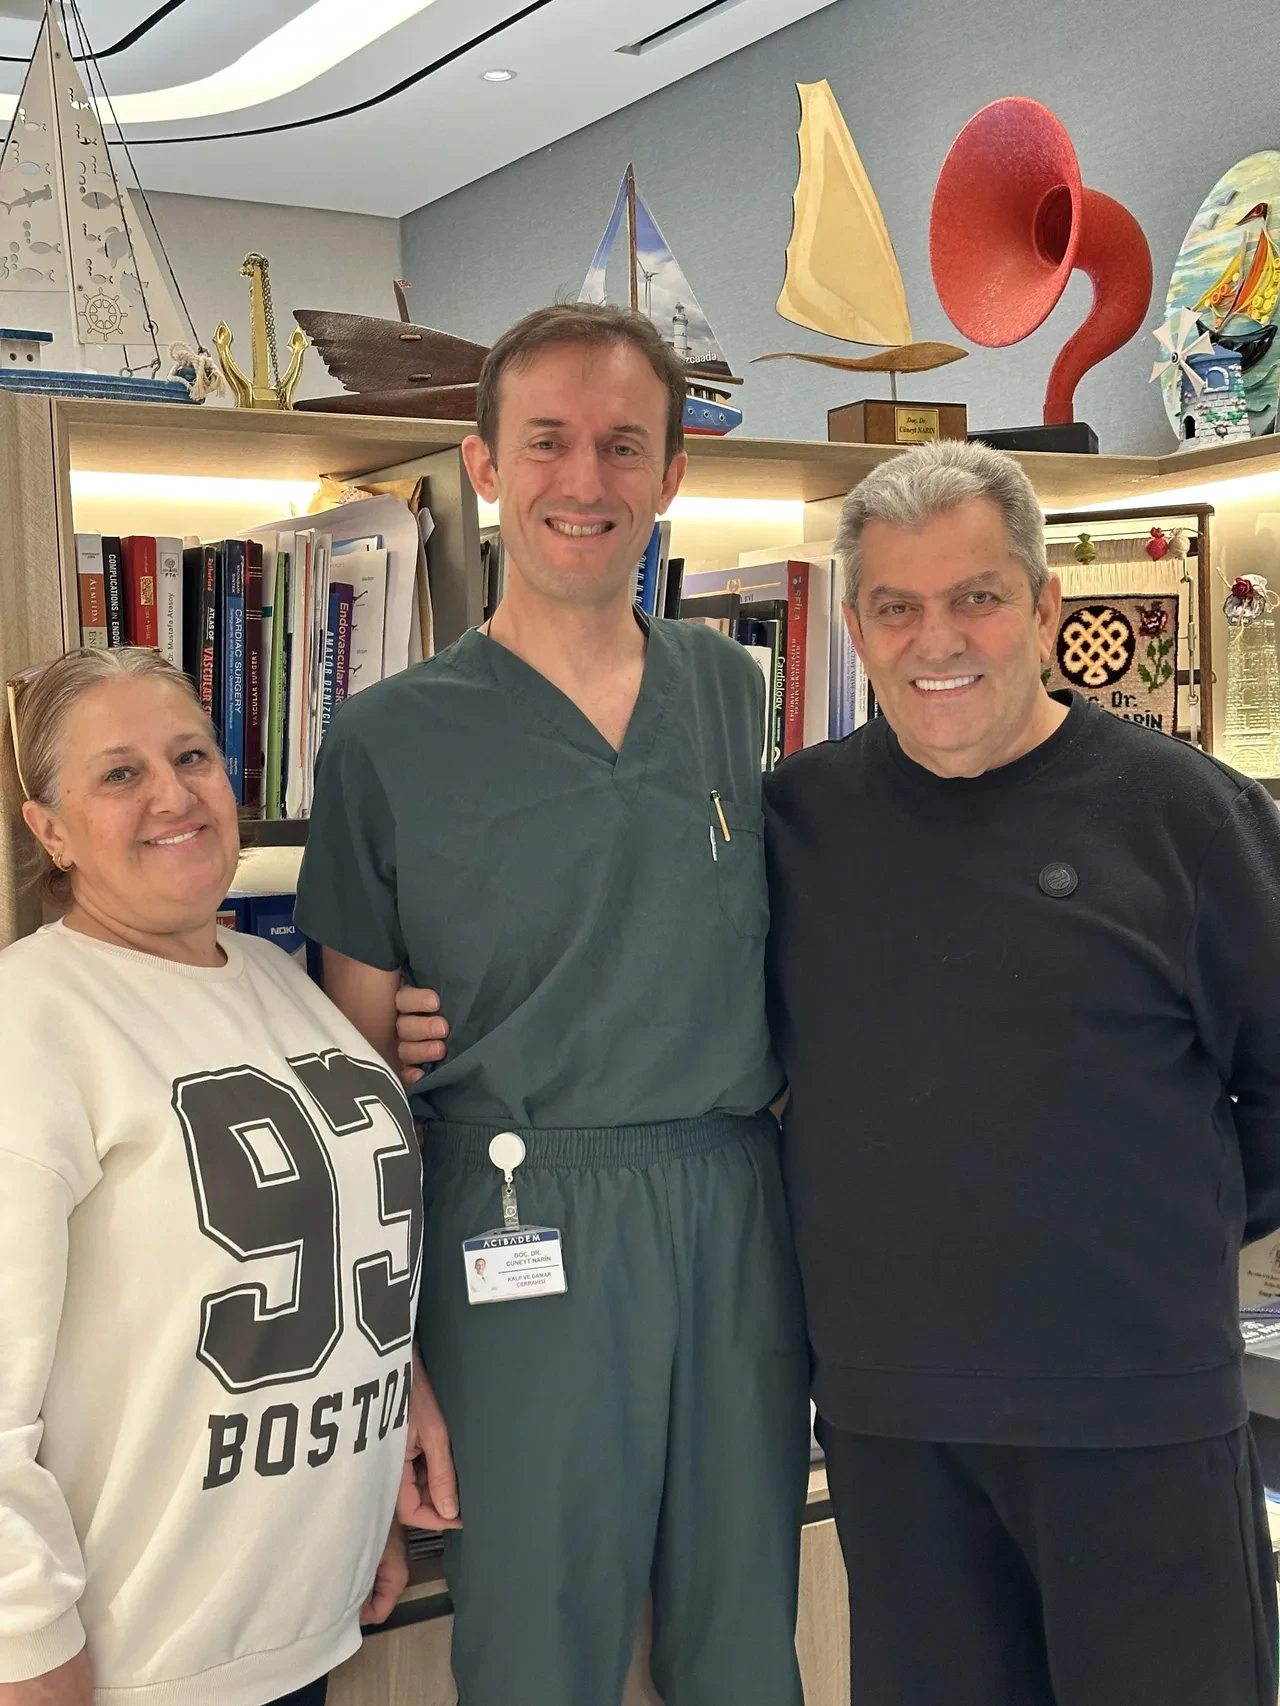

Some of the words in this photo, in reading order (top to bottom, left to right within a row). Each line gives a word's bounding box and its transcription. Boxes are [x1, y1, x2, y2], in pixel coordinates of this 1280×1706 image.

[89, 579, 99, 623] ALMEIDA
[108, 554, 119, 611] COMPLICATIONS
[167, 592, 175, 619] Atasoy
[208, 607, 216, 630] ATLAS
[208, 630, 215, 641] OF
[234, 608, 243, 658] CARDIAC
[324, 630, 335, 675] AMATÖR
[336, 602, 349, 688] Endovascular
[202, 647, 214, 701] VASCULAR
[234, 661, 242, 714] SURGERY
[775, 656, 786, 710] Cardiology
[848, 691, 856, 721] SURGERY
[1112, 690, 1138, 708] Dr.
[170, 1047, 424, 1395] 93
[483, 1233, 541, 1248] ACIBADEM
[506, 1258, 531, 1267] CÜNEYT
